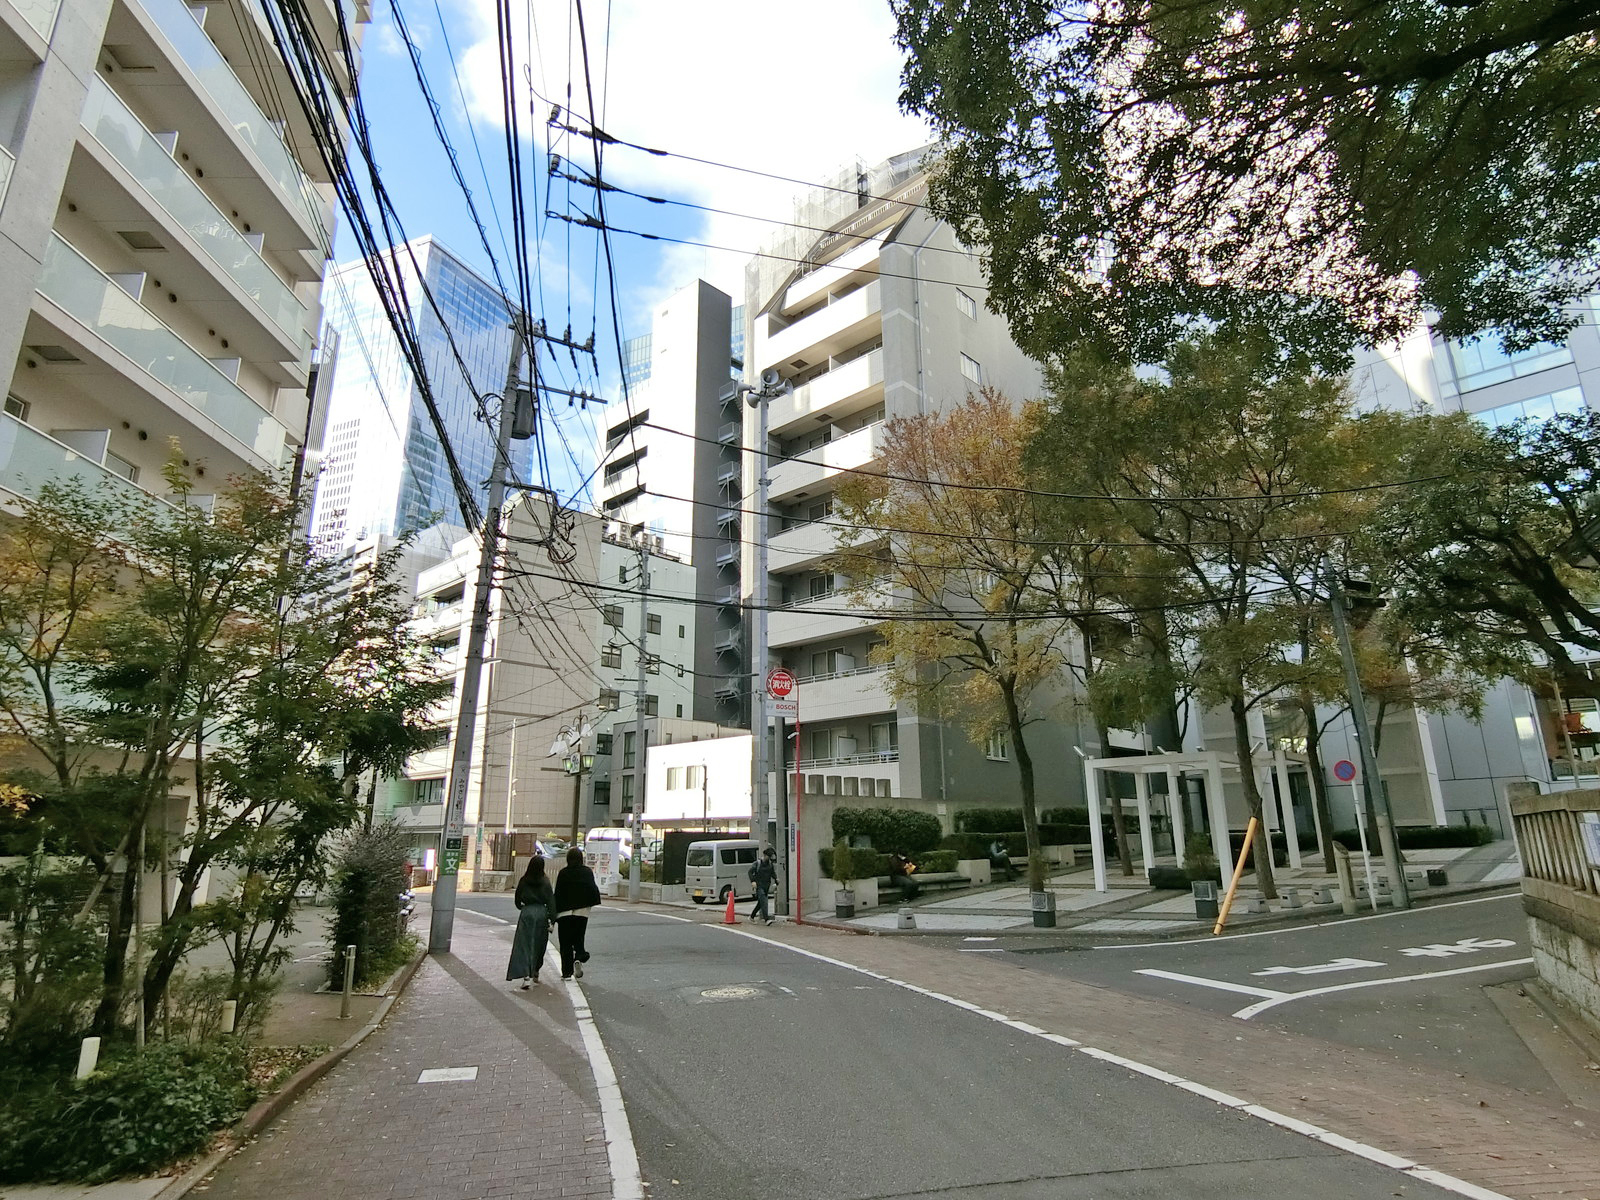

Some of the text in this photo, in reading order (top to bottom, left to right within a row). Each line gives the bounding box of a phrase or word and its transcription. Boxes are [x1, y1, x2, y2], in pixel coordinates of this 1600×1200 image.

[773, 680, 791, 690] 消火栓
[445, 857, 457, 870] 文
